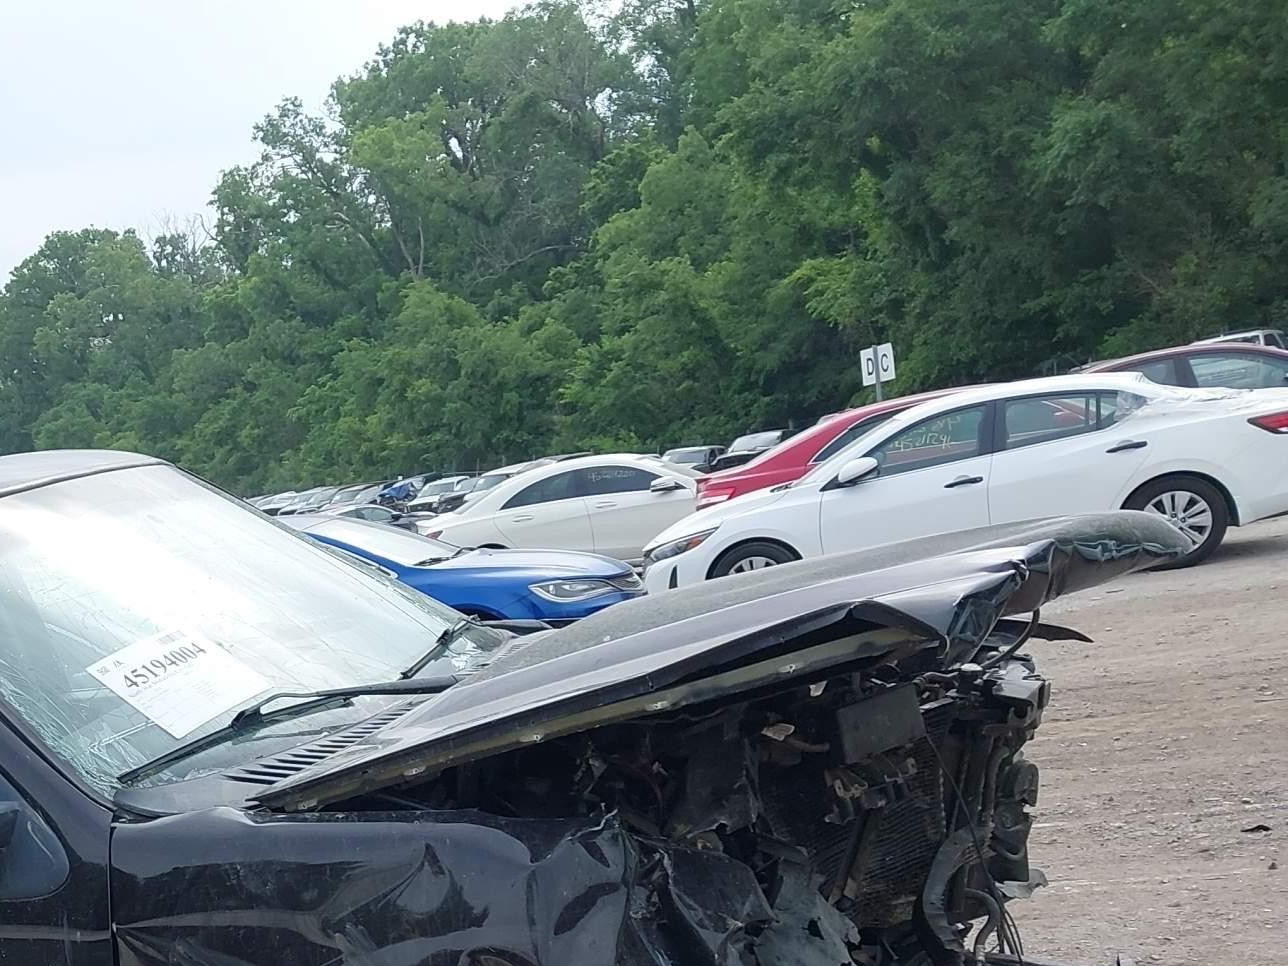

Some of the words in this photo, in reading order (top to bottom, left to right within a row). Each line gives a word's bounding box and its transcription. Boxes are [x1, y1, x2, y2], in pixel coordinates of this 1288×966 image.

[866, 357, 875, 376] D
[881, 353, 890, 372] C
[123, 642, 207, 689] 45194004
